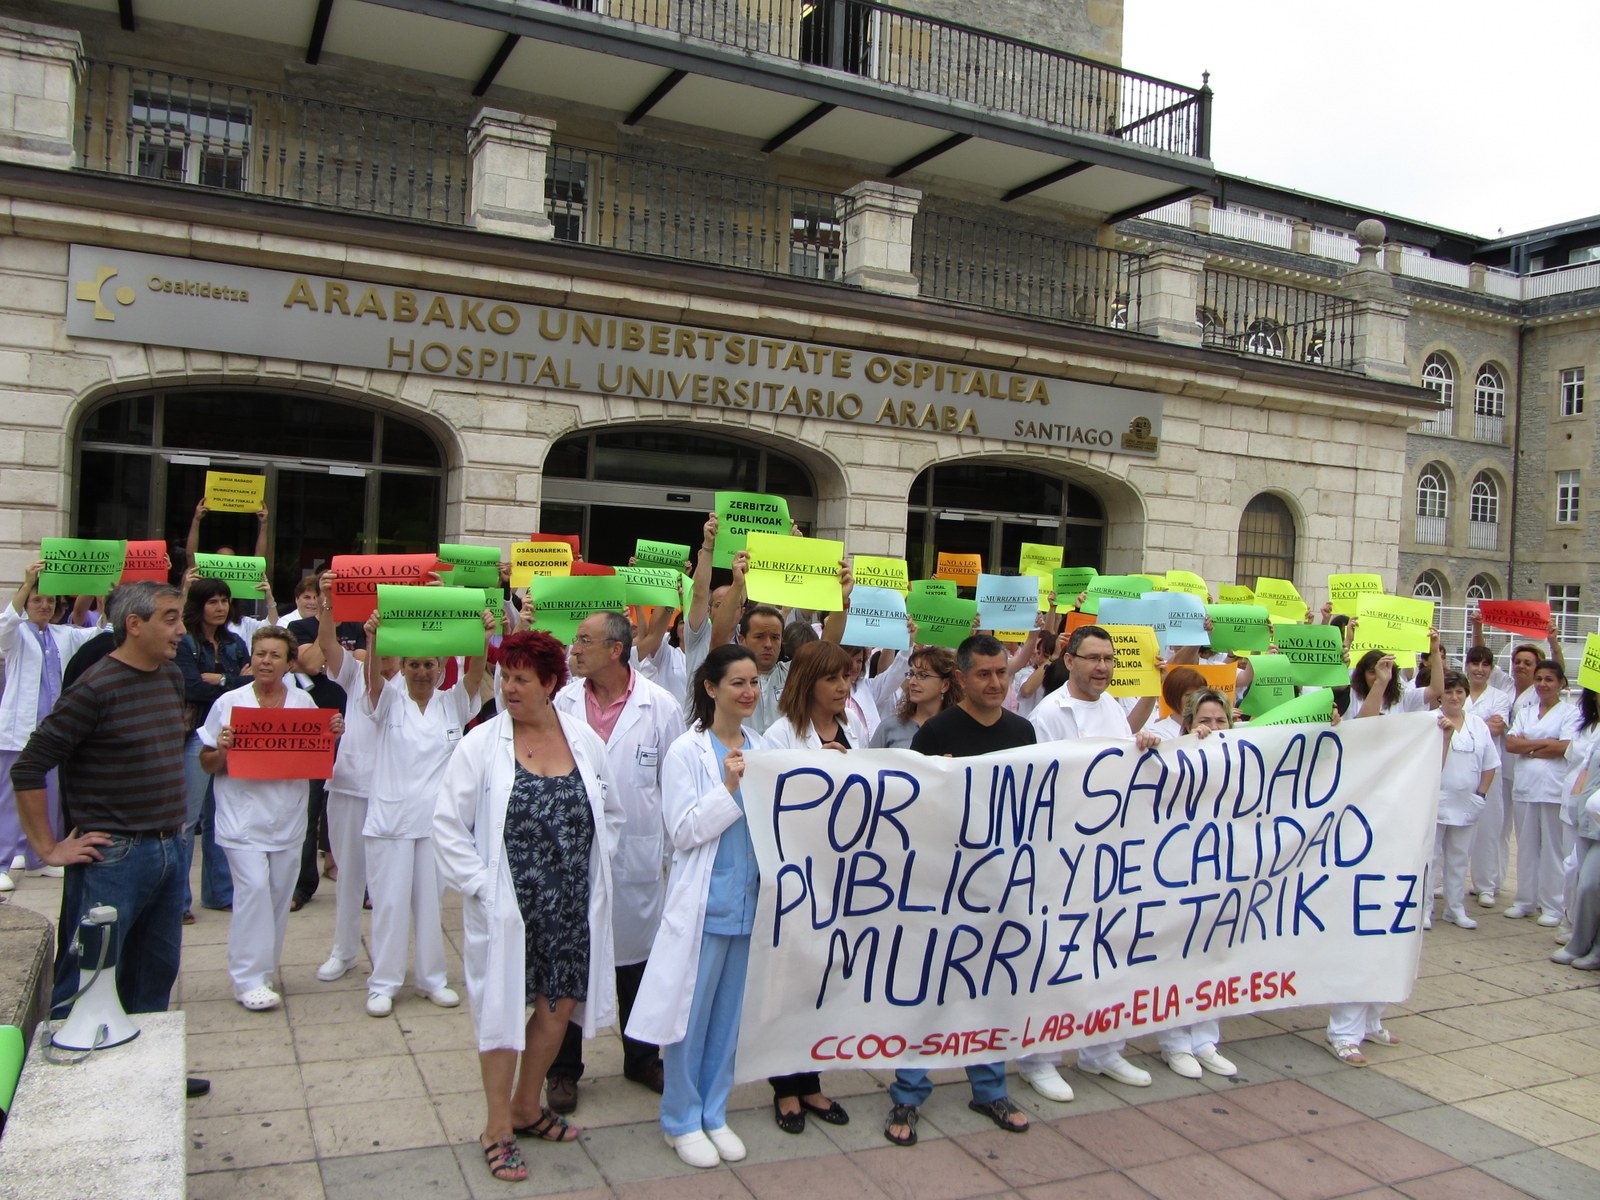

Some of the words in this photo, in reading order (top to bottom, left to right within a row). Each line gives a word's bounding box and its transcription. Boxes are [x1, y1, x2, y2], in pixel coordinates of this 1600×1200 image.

[148, 274, 249, 302] Osakidetza
[284, 276, 520, 335] ARABAKO
[538, 310, 852, 378] UNIBERTSITATE
[865, 356, 1050, 405] OSPITALEA
[387, 337, 581, 388] HOSPITAL
[598, 362, 863, 420] UNIVERSITARIO
[875, 397, 980, 434] ARABA
[1014, 420, 1114, 446] SANTIAGO
[730, 501, 778, 512] ZERBITZU
[726, 514, 782, 526] PUBLIKOAK
[44, 550, 77, 560] ¡¡¡NO
[44, 562, 115, 573] RECORTES!!!
[336, 566, 372, 578] ¡¡¡NO
[377, 566, 386, 575] A
[392, 565, 420, 575] LOS
[750, 560, 838, 575] ¡¡MURRIZKETARIK
[785, 574, 803, 583] EZ!!
[536, 600, 622, 609] ¡¡MURRIZKETARIK
[383, 610, 480, 618] ¡¡MURRIZKETARIK
[1278, 638, 1303, 648] ¡¡¡NO
[1316, 640, 1336, 648] LOS
[235, 722, 273, 734] ¡¡¡NO
[277, 723, 287, 732] A
[292, 722, 321, 732] LOS
[232, 737, 330, 749] RECORTES!!!
[774, 767, 920, 862] POR
[958, 759, 1060, 849] UNA
